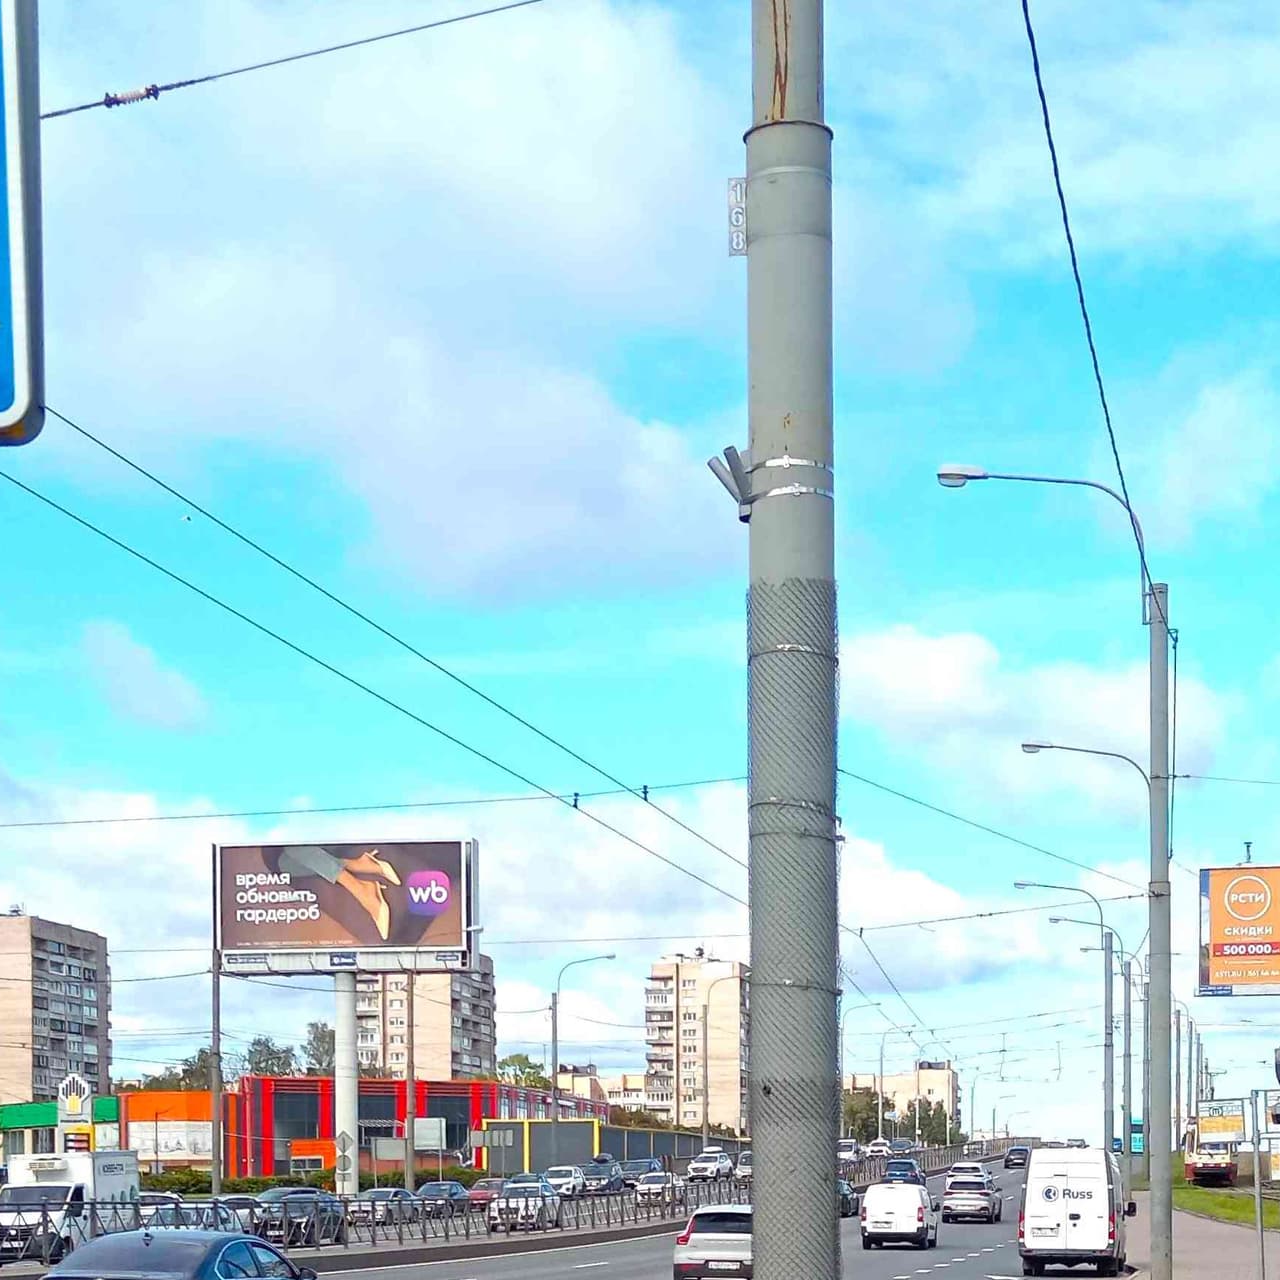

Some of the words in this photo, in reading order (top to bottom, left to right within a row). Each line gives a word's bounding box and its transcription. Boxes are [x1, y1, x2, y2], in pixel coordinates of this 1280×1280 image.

[235, 872, 291, 889] время
[235, 888, 317, 904] обновить
[408, 879, 448, 904] wb
[1230, 893, 1265, 903] РСТИ
[235, 904, 321, 925] гардероб
[1223, 926, 1273, 937] скидки
[1222, 944, 1246, 955] 500
[1247, 943, 1272, 954] 000
[1062, 1188, 1093, 1200] Russ
